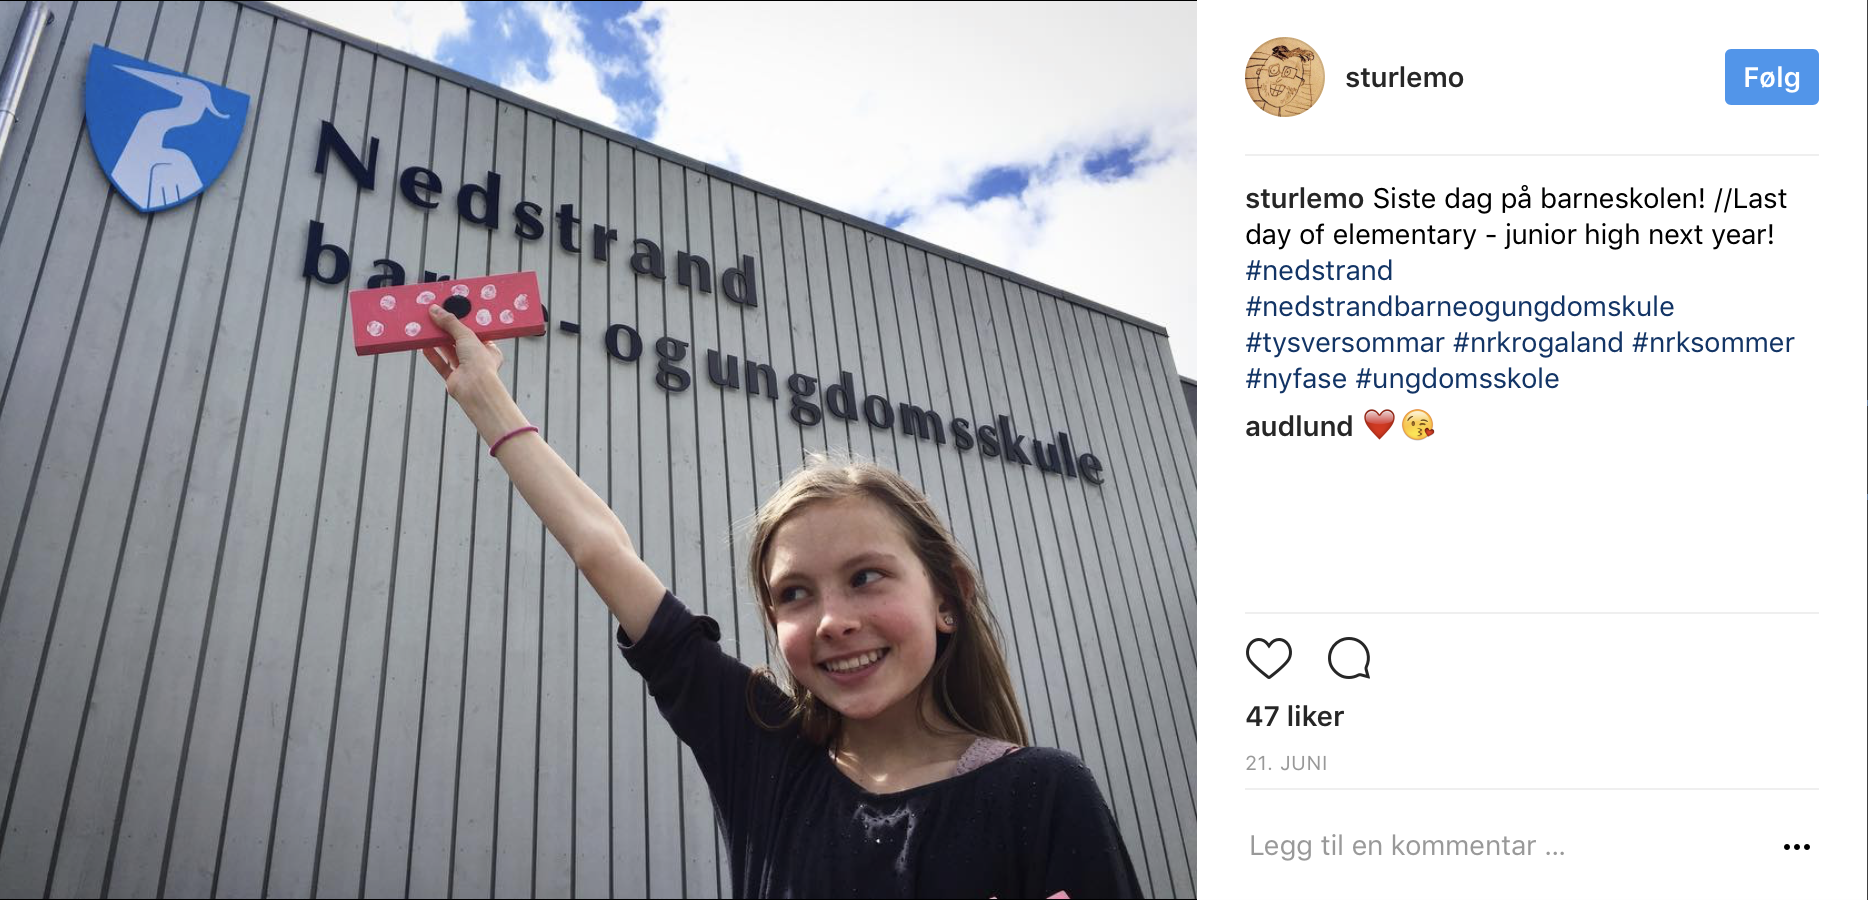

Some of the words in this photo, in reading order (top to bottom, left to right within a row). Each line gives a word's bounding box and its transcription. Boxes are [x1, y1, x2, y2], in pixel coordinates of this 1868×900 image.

[314, 119, 759, 309] Nedstrand
[604, 322, 692, 393] og
[706, 346, 1104, 485] ungdomsskule
